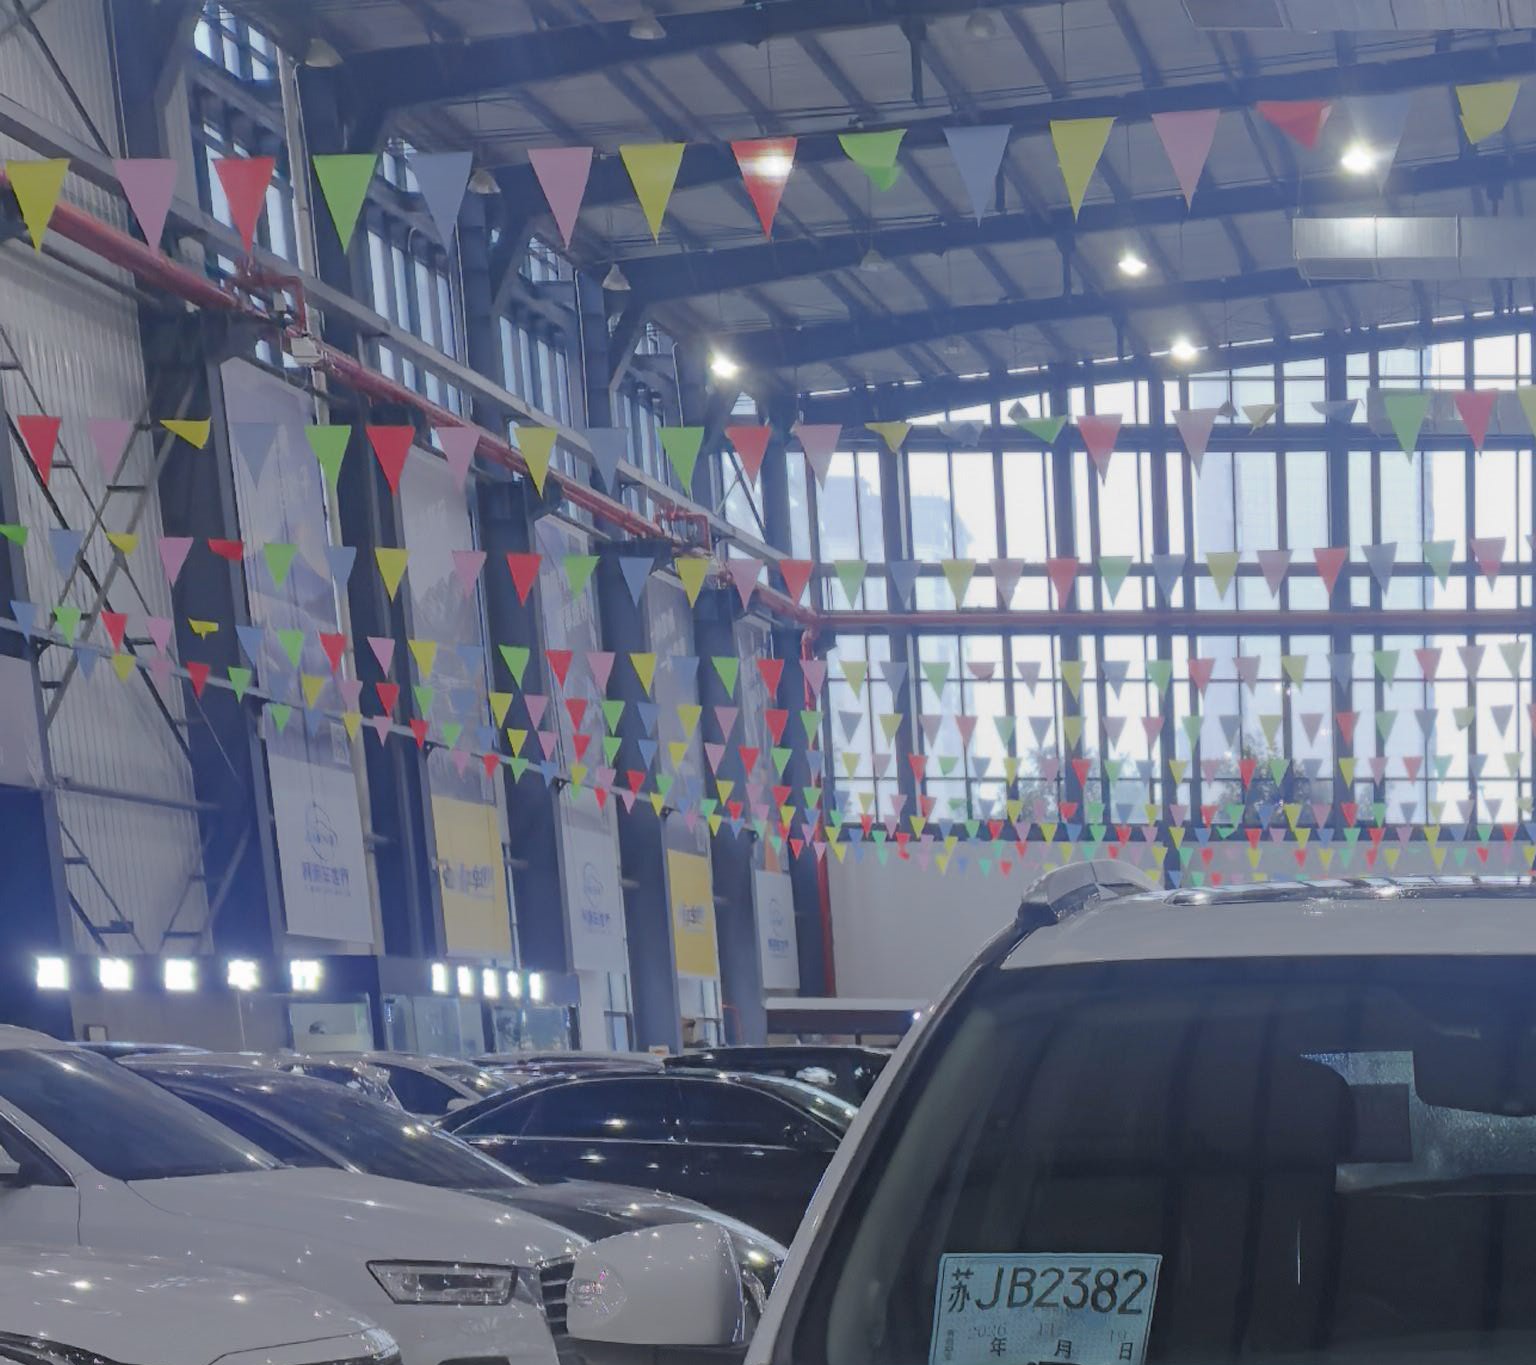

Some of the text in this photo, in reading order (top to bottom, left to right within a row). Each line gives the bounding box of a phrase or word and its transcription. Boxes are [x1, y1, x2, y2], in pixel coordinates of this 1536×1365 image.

[947, 1267, 1148, 1315] 苏JB2382
[990, 1336, 1134, 1361] 年 月 日
